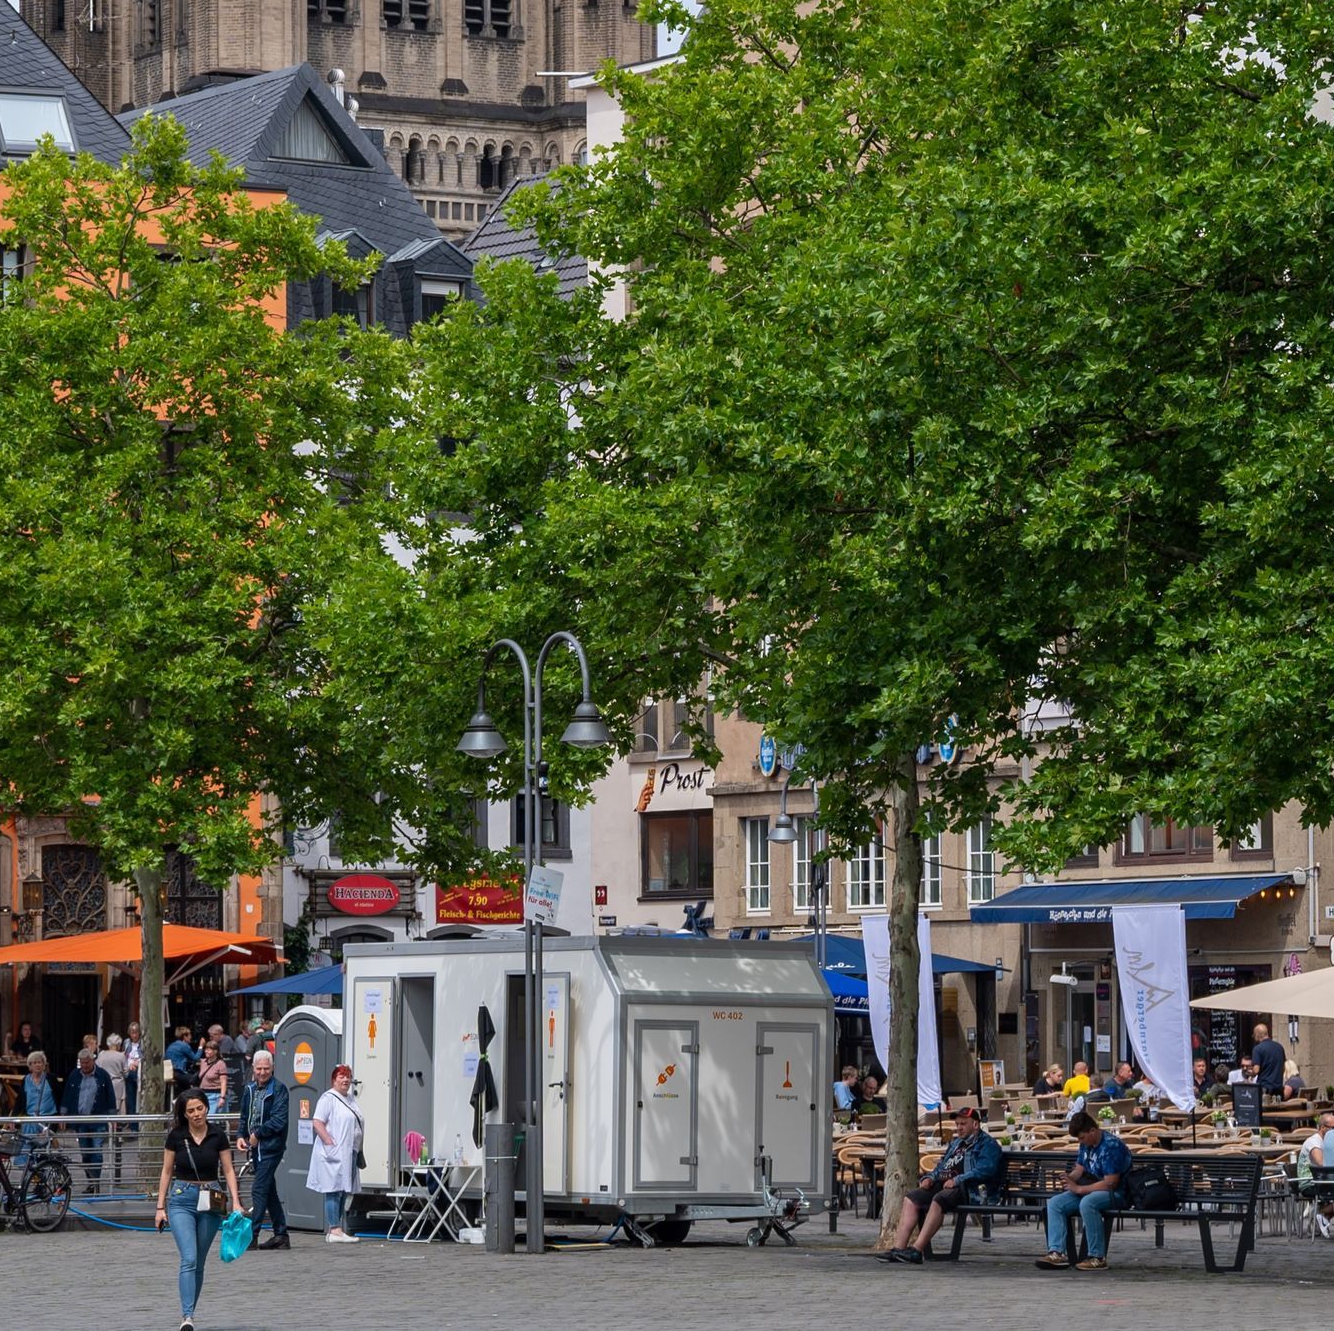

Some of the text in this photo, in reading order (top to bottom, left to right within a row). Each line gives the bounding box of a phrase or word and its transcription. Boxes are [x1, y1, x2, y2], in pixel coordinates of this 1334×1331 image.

[659, 762, 711, 794] Prost
[334, 886, 395, 900] HACIENDA
[529, 887, 544, 897] Free
[528, 895, 538, 904] für
[439, 909, 521, 921] Fleisch- & Fischgerichte
[713, 1011, 743, 1021] WC 402
